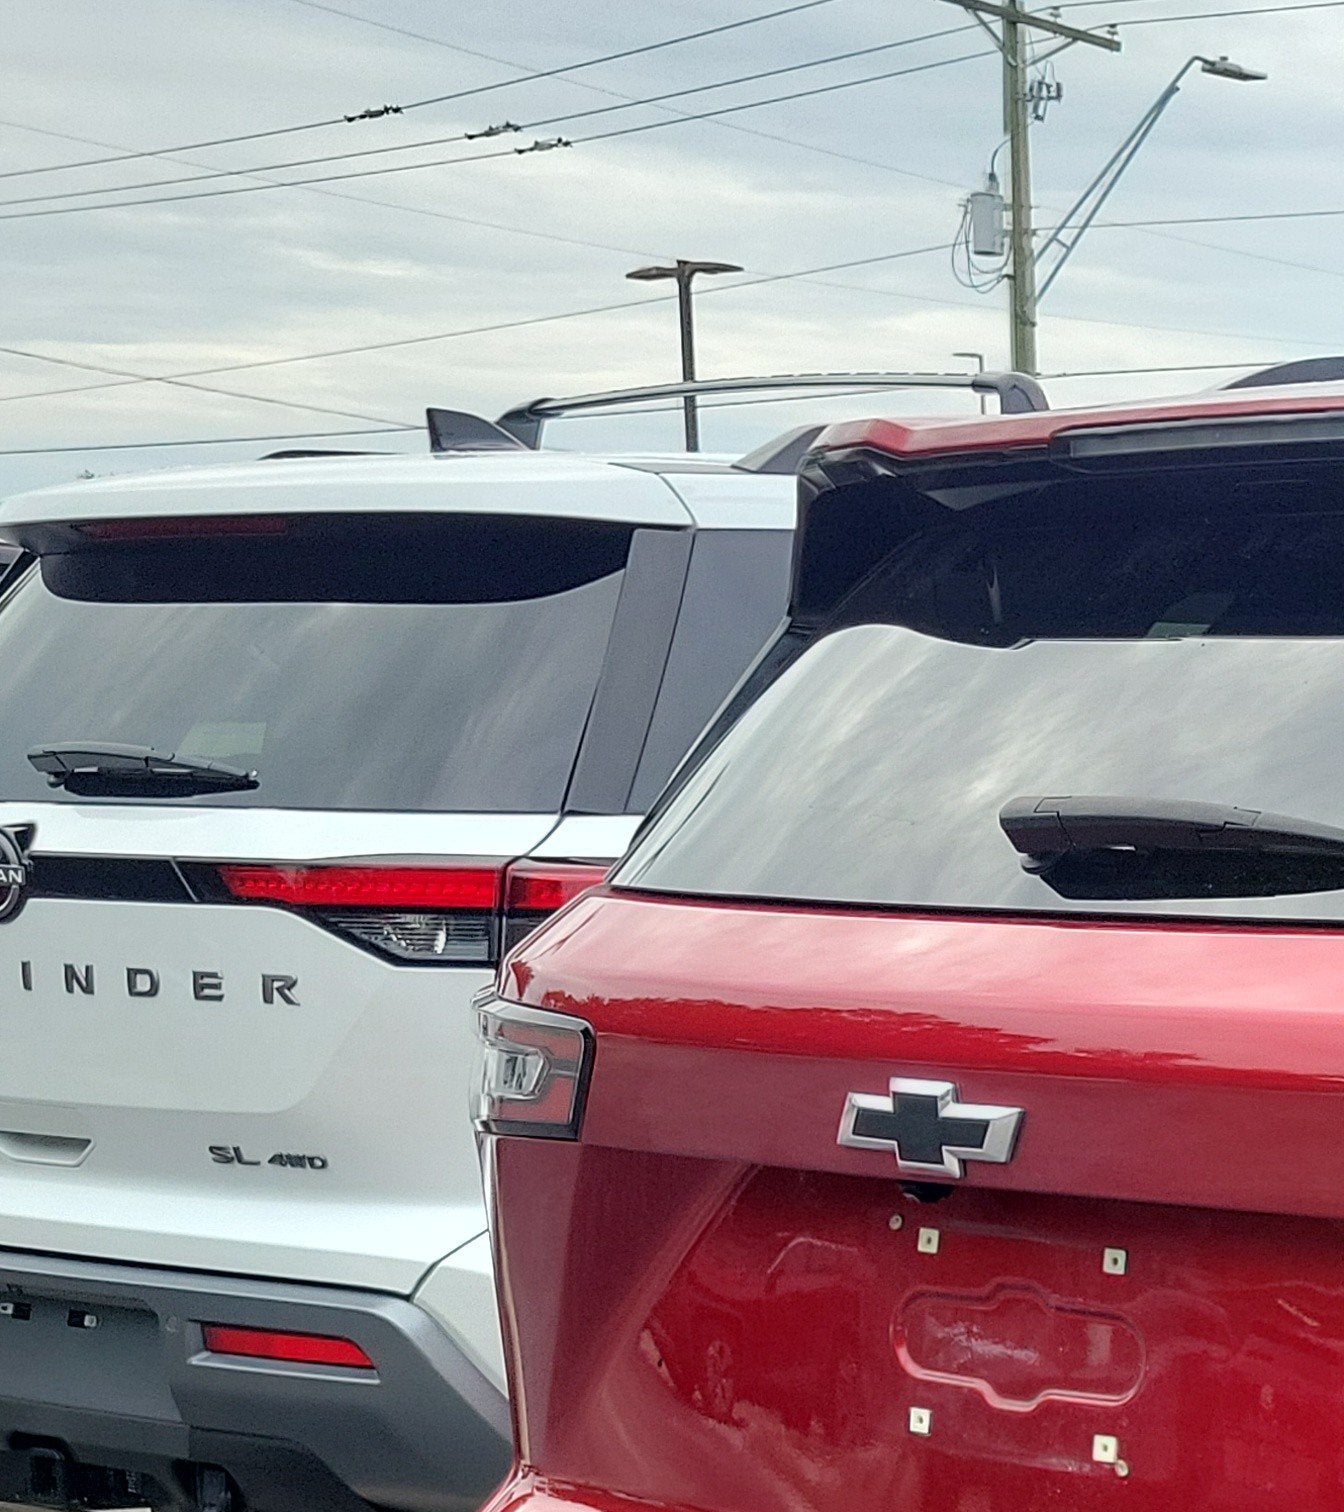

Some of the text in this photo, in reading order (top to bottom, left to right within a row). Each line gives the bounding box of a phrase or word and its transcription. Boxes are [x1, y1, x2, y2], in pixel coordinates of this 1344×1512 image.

[20, 960, 301, 1007] INDER
[208, 1145, 329, 1170] SL 4WD
